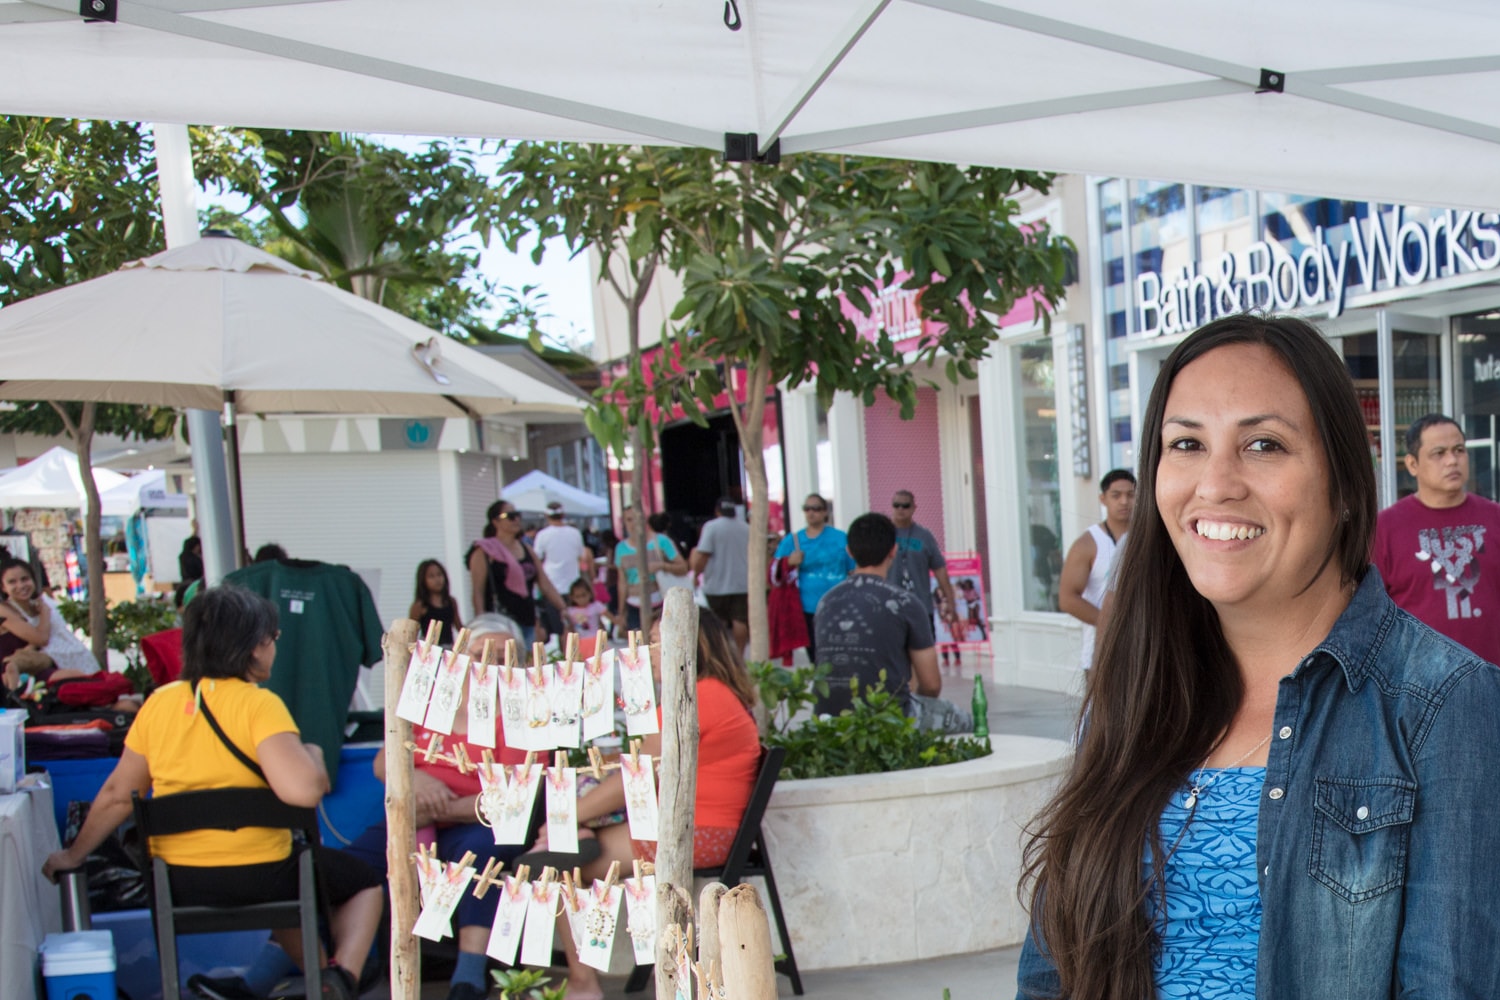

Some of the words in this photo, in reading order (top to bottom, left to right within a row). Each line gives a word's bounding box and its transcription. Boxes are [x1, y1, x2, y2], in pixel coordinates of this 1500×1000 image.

[1137, 262, 1212, 339] Bath
[1214, 251, 1244, 318] &
[1249, 224, 1349, 318] Body
